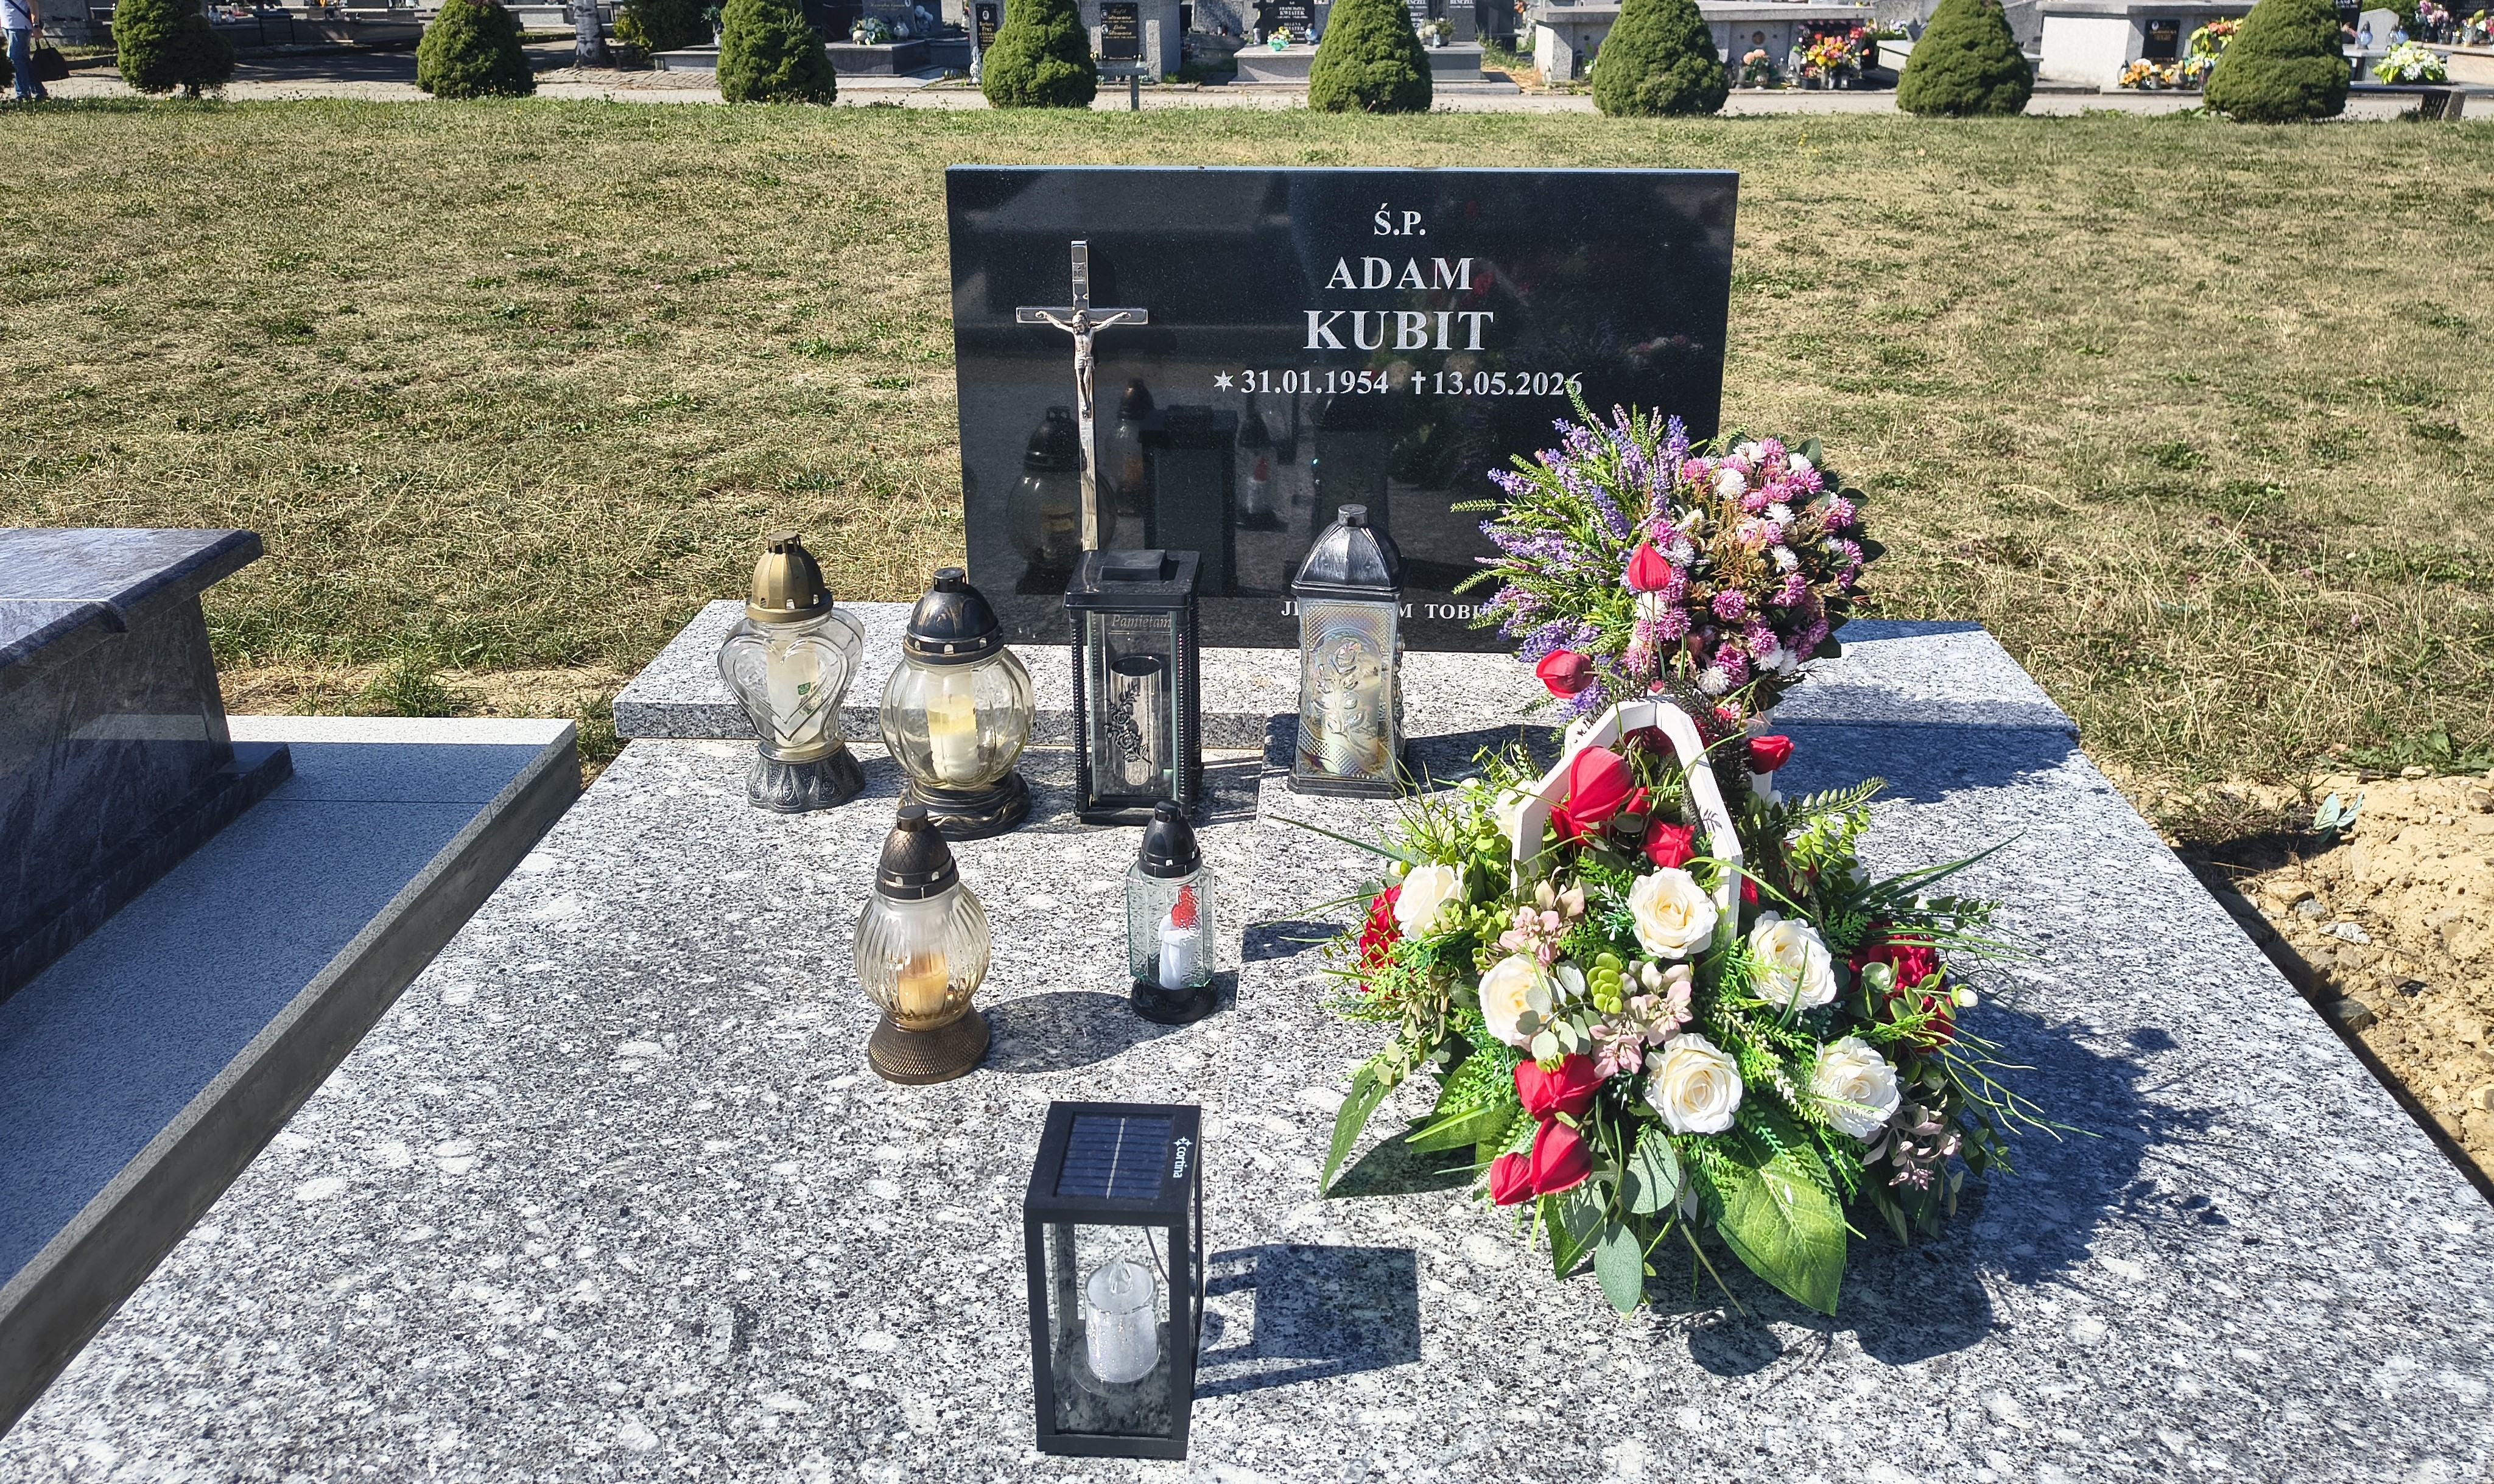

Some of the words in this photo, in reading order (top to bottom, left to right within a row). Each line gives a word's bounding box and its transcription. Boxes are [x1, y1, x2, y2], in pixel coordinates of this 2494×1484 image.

[1374, 203, 1426, 236] Ś.P.
[1324, 256, 1475, 290] ADAM
[1302, 310, 1494, 350] KUBIT
[1240, 369, 1389, 394] 31.01.1954
[1433, 371, 1583, 396] 13.05.2026
[1424, 604, 1487, 620] TOBI
[1173, 1146, 1187, 1178] cortina
